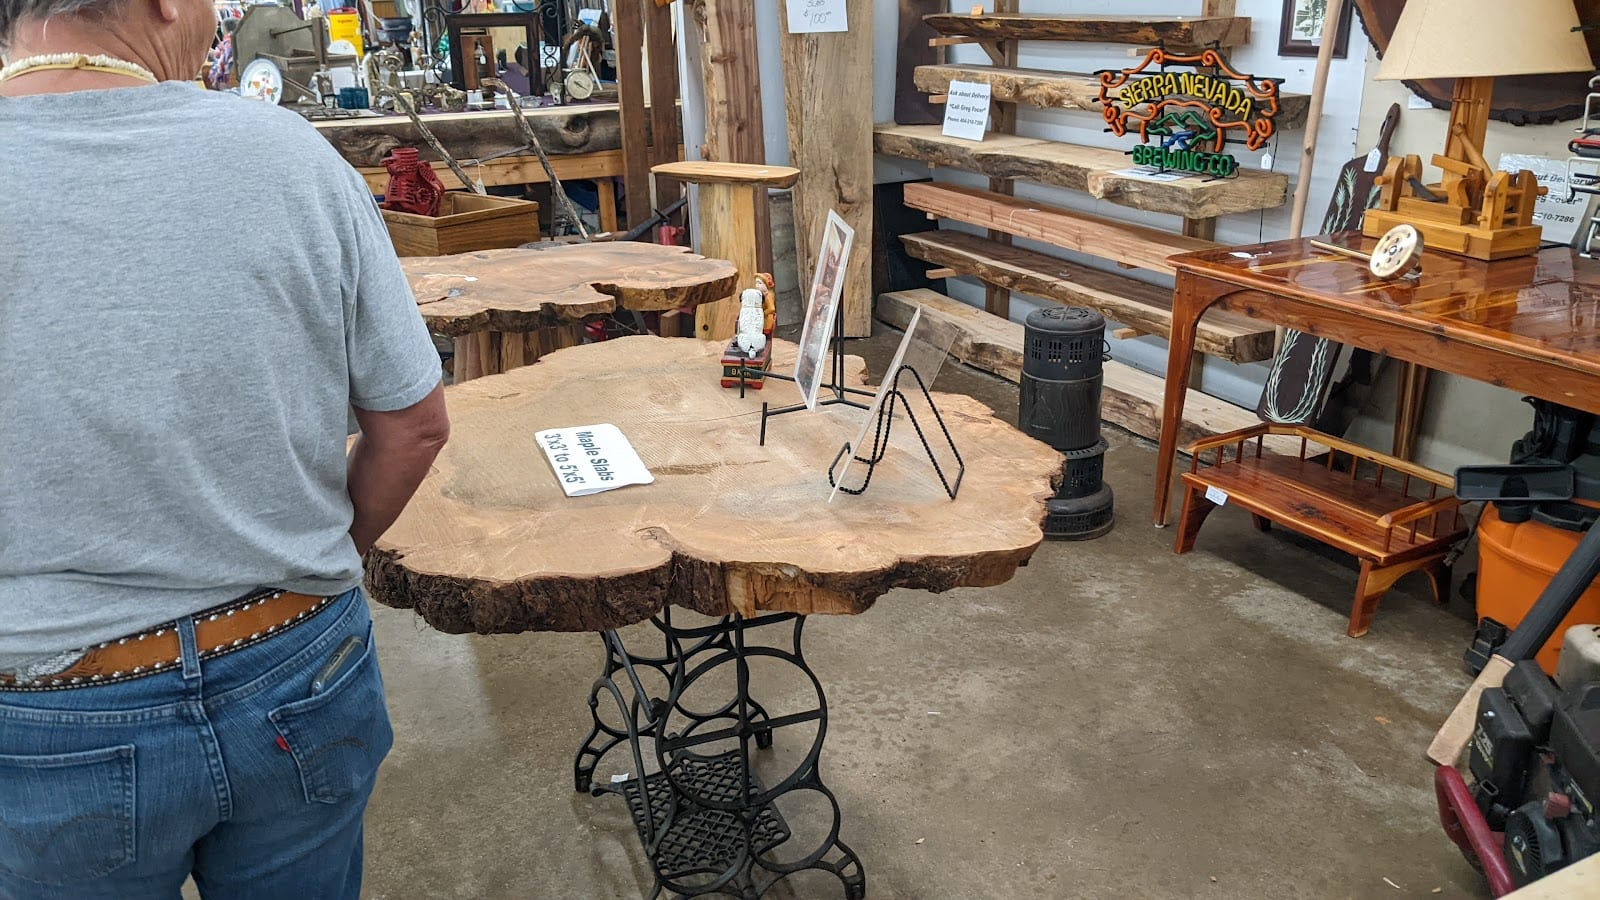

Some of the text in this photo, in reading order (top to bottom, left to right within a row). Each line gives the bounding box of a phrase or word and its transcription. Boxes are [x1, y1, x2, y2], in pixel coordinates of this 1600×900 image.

[1119, 72, 1252, 121] SIERRA NEVADA
[1132, 145, 1234, 177] BREWING CO
[544, 433, 586, 484] 3'x3' to 5'x5'
[575, 431, 615, 482] Maple Slabs
